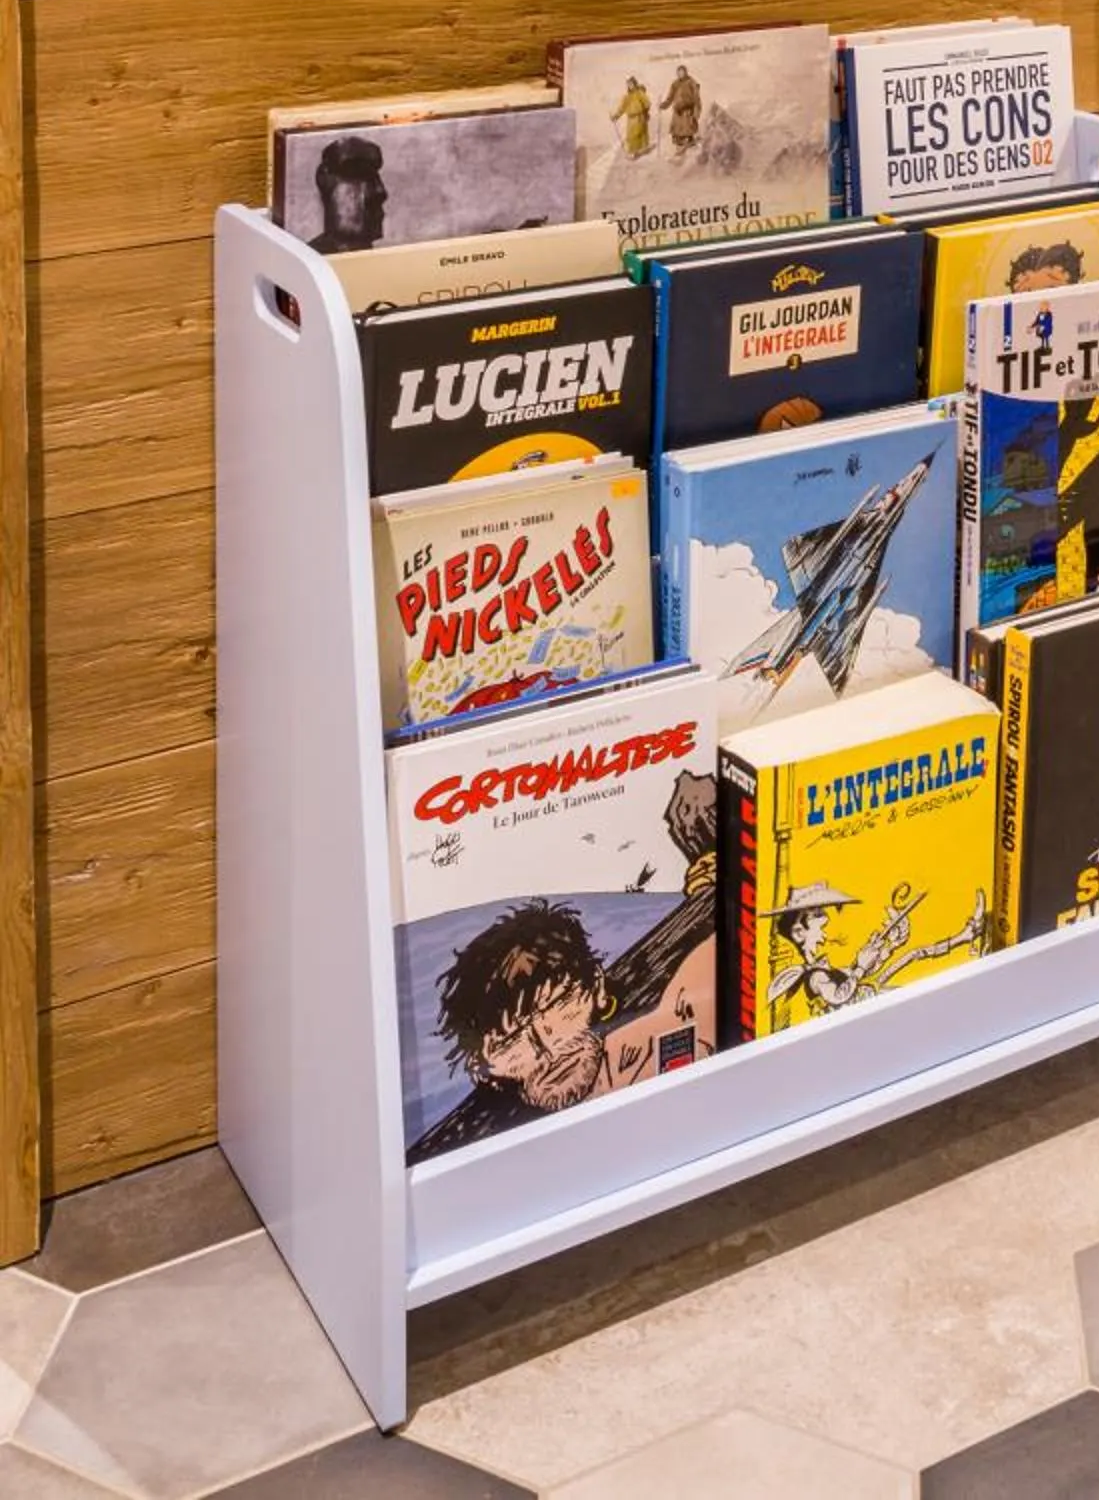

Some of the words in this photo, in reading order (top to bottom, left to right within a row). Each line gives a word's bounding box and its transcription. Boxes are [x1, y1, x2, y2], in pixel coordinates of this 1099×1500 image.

[884, 77, 926, 105] FAUT
[933, 72, 965, 100] PAS
[971, 63, 1050, 94] PRENDRE
[885, 102, 949, 156] LES
[962, 89, 1052, 146] CONS
[888, 156, 938, 187] POUR
[944, 150, 979, 179] DES
[984, 143, 1031, 174] GENS
[1032, 139, 1053, 166] 02
[735, 192, 761, 219] du
[471, 316, 557, 343] MARGERIN
[740, 311, 767, 334] GIL
[770, 296, 853, 329] JOURDAN
[743, 321, 848, 358] L'INTÉGRALE
[390, 335, 635, 429] LUCIEN
[997, 348, 1053, 394] TIF
[1056, 356, 1075, 377] et
[578, 391, 621, 412] VOL.1
[965, 402, 978, 434] TIF
[964, 449, 978, 523] TONDU
[403, 543, 433, 581] LES
[396, 536, 529, 638] PIEDS
[1007, 673, 1023, 750] SPIROU
[493, 816, 509, 829] Le
[512, 807, 541, 827] Jour
[543, 802, 560, 815] de
[1001, 752, 1020, 851] FANTASIO
